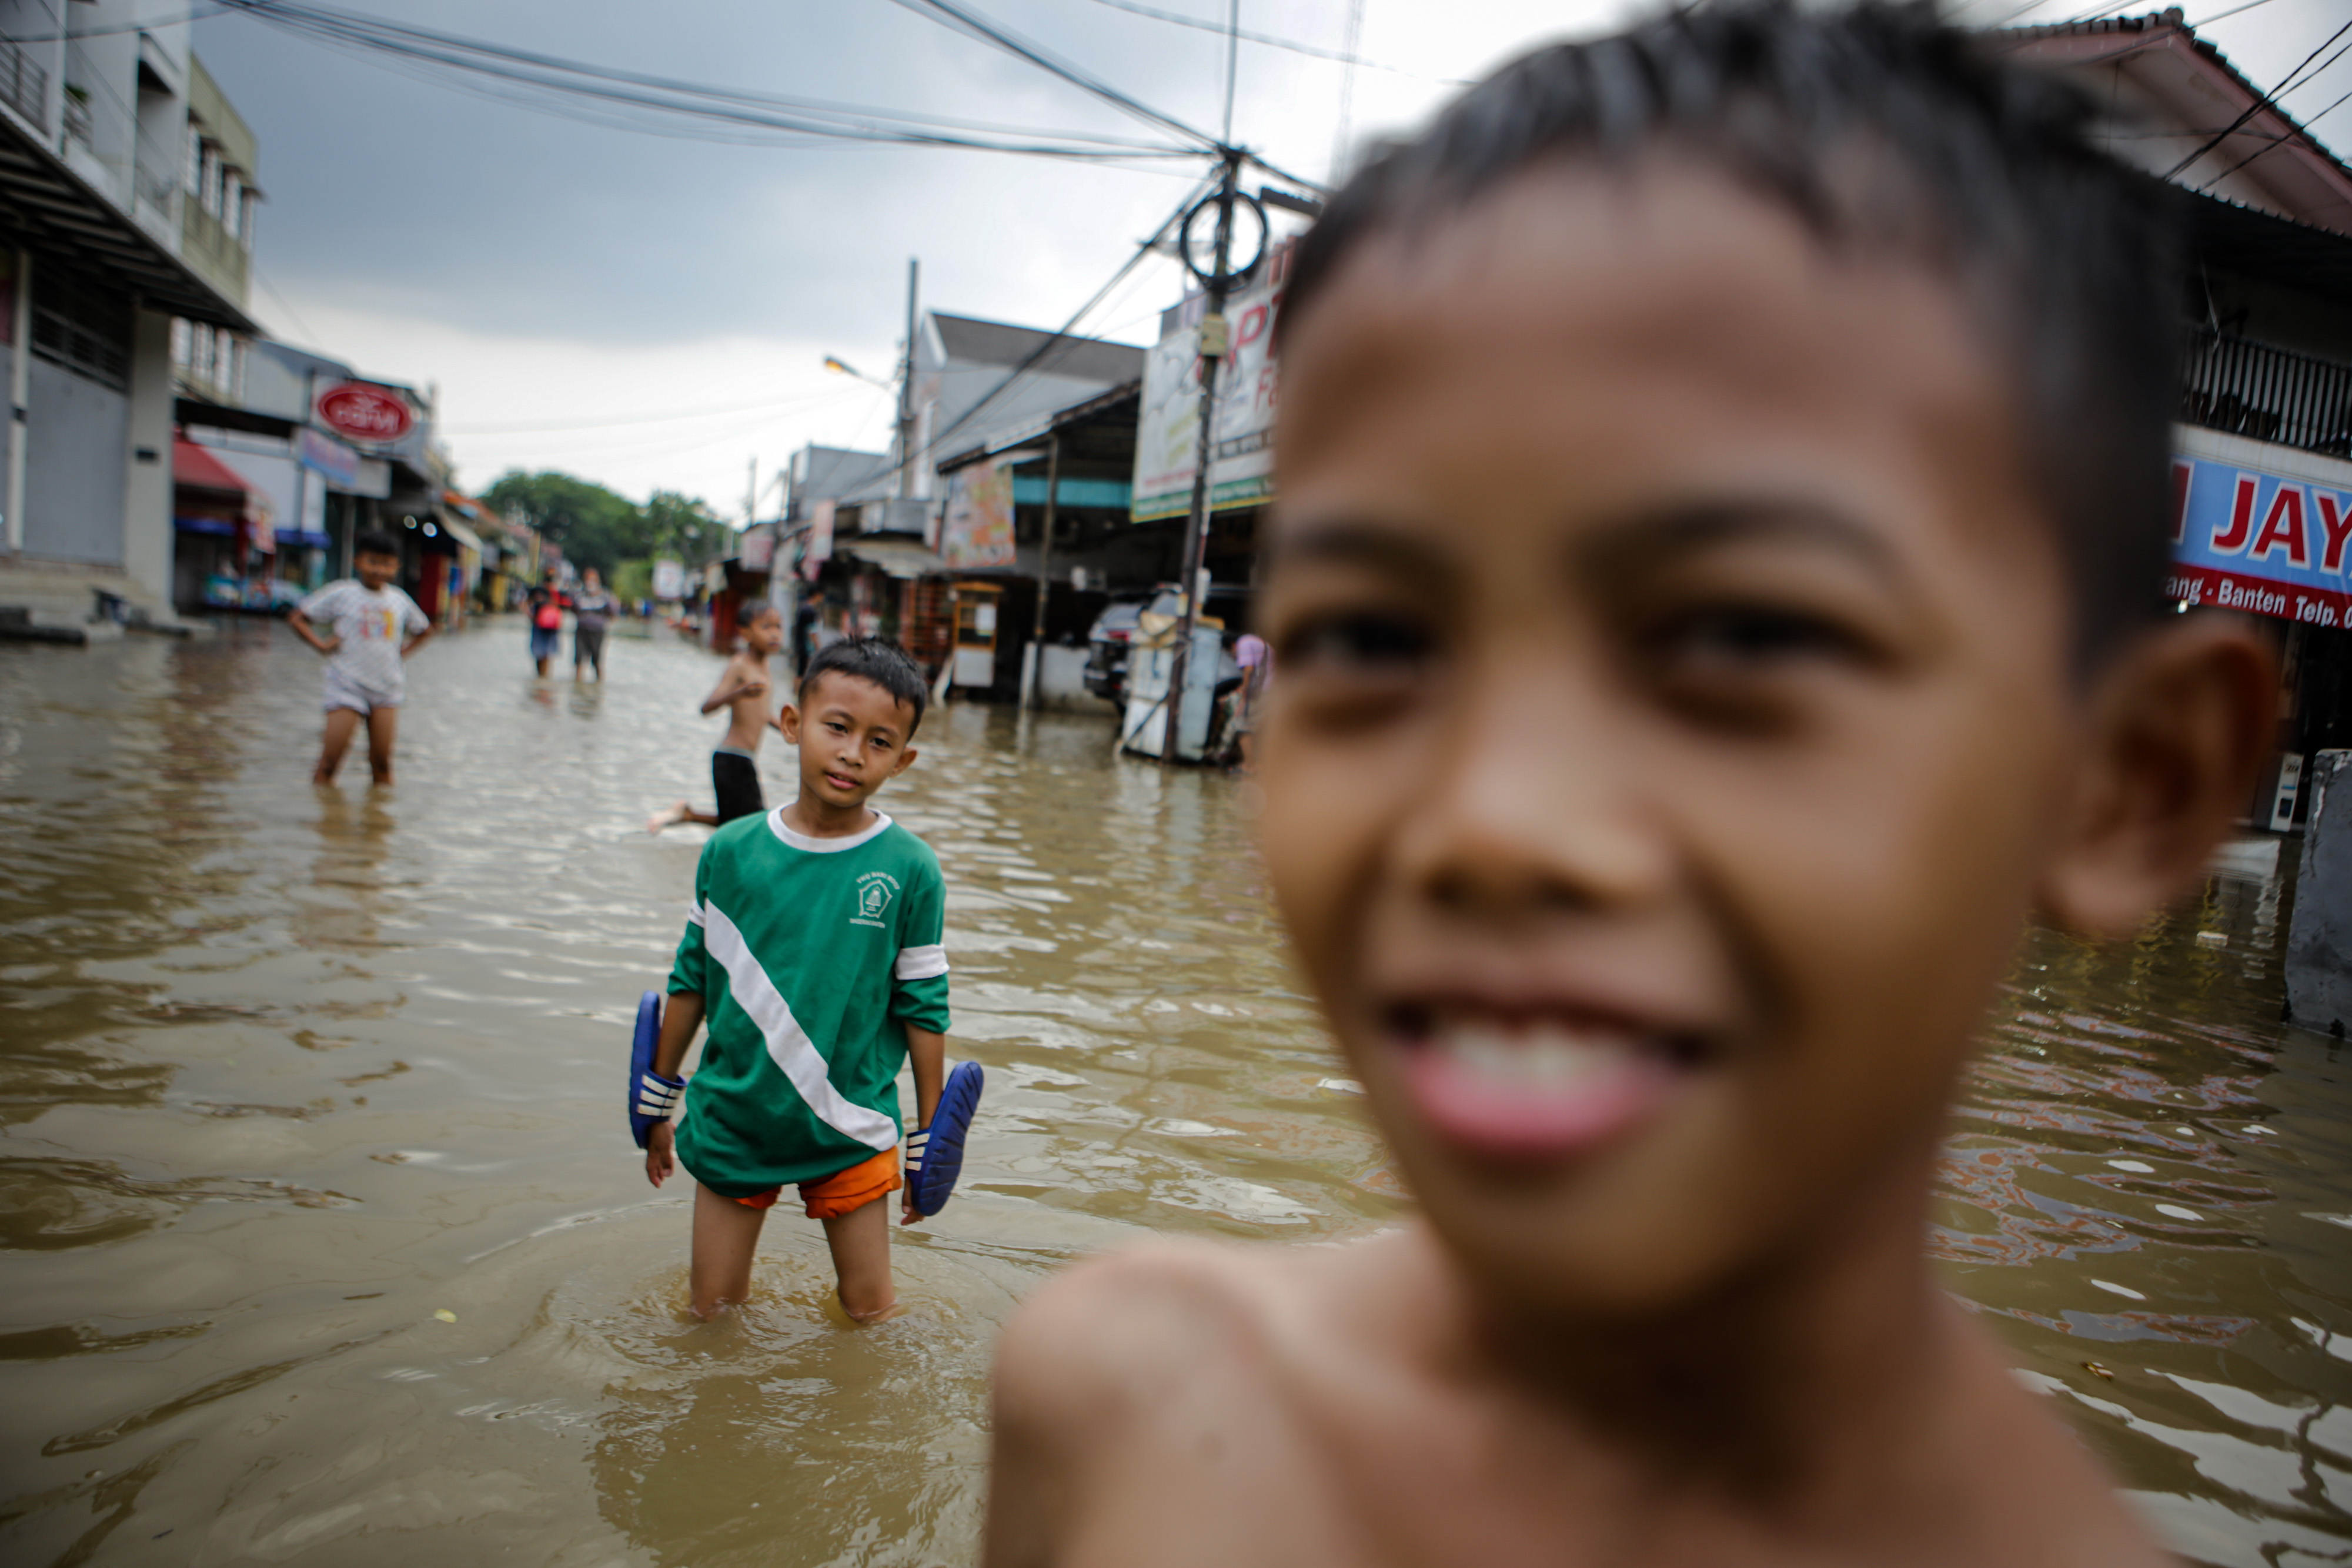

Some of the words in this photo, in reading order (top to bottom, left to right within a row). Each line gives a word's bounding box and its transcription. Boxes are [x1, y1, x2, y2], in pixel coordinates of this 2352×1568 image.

[2209, 472, 2352, 578] JAY
[2164, 576, 2205, 605] ang
[2218, 579, 2286, 614] Banten
[2295, 594, 2339, 627] Telp.
